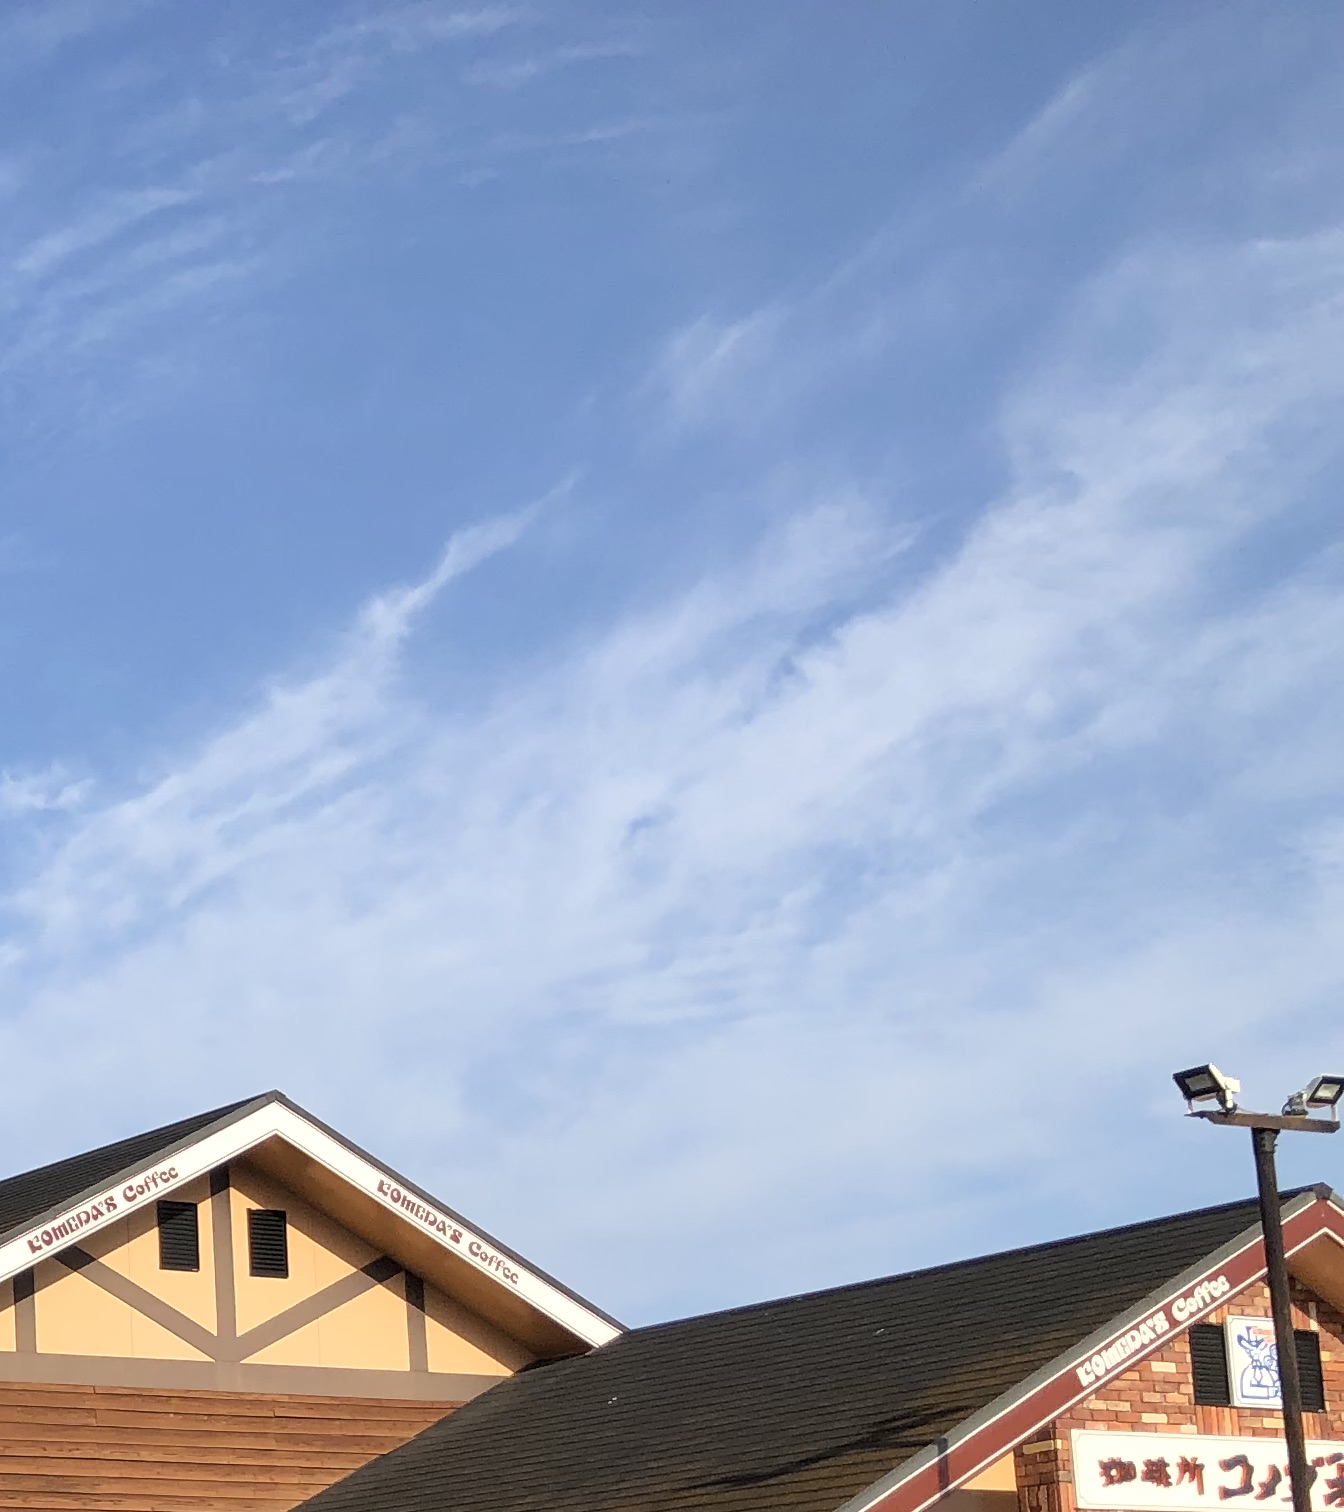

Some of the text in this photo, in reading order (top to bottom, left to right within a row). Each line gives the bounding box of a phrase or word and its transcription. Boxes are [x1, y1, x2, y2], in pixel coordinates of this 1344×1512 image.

[26, 1167, 179, 1254] KOMEDA'S Coffee
[376, 1179, 519, 1285] KOMEDA'S Coffee
[1075, 1274, 1231, 1388] KOMEDA'S Coffee
